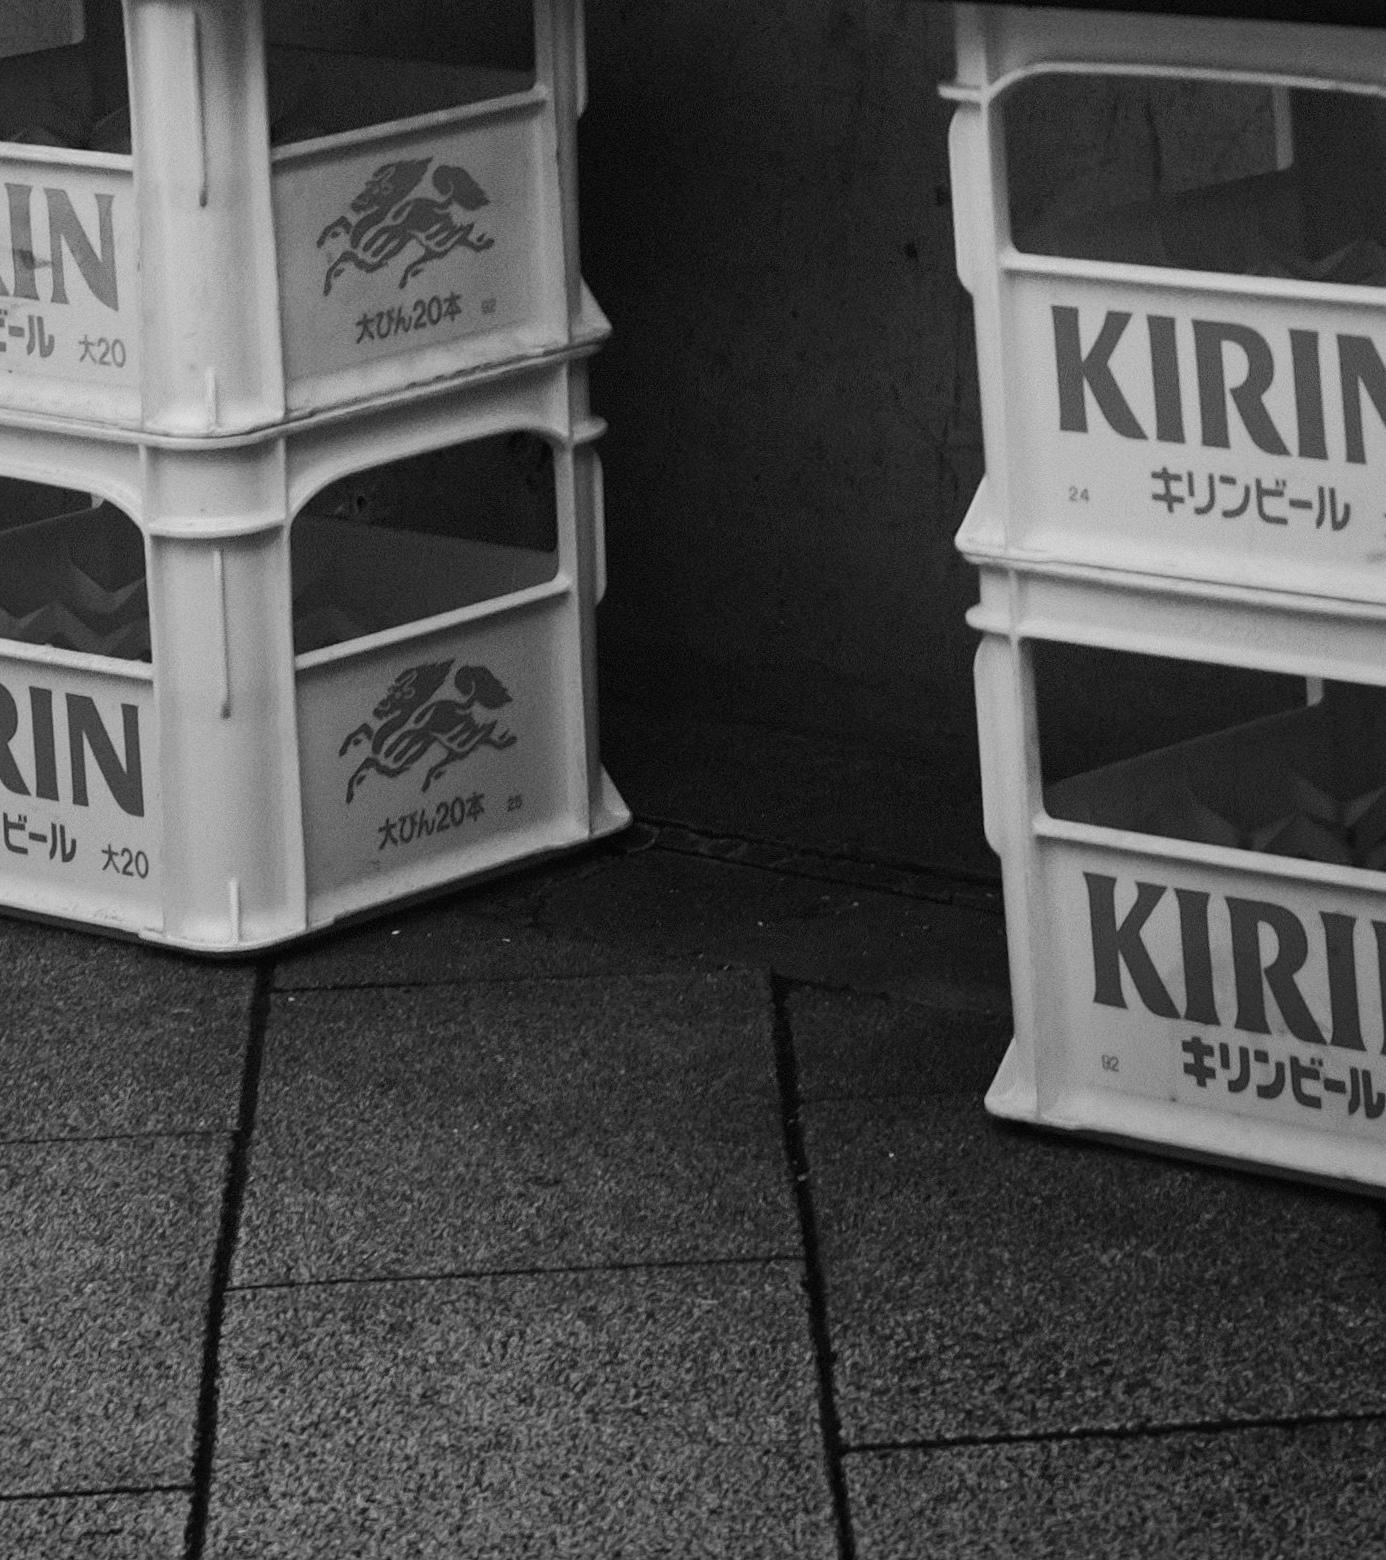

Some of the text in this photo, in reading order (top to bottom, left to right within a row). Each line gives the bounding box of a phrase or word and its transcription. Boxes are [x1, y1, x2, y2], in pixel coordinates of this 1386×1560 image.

[356, 291, 463, 345] 大びん20本
[1150, 467, 1352, 533] キリンビール
[377, 792, 486, 852] 大びん20本
[1182, 1035, 1386, 1120] キリンビール
